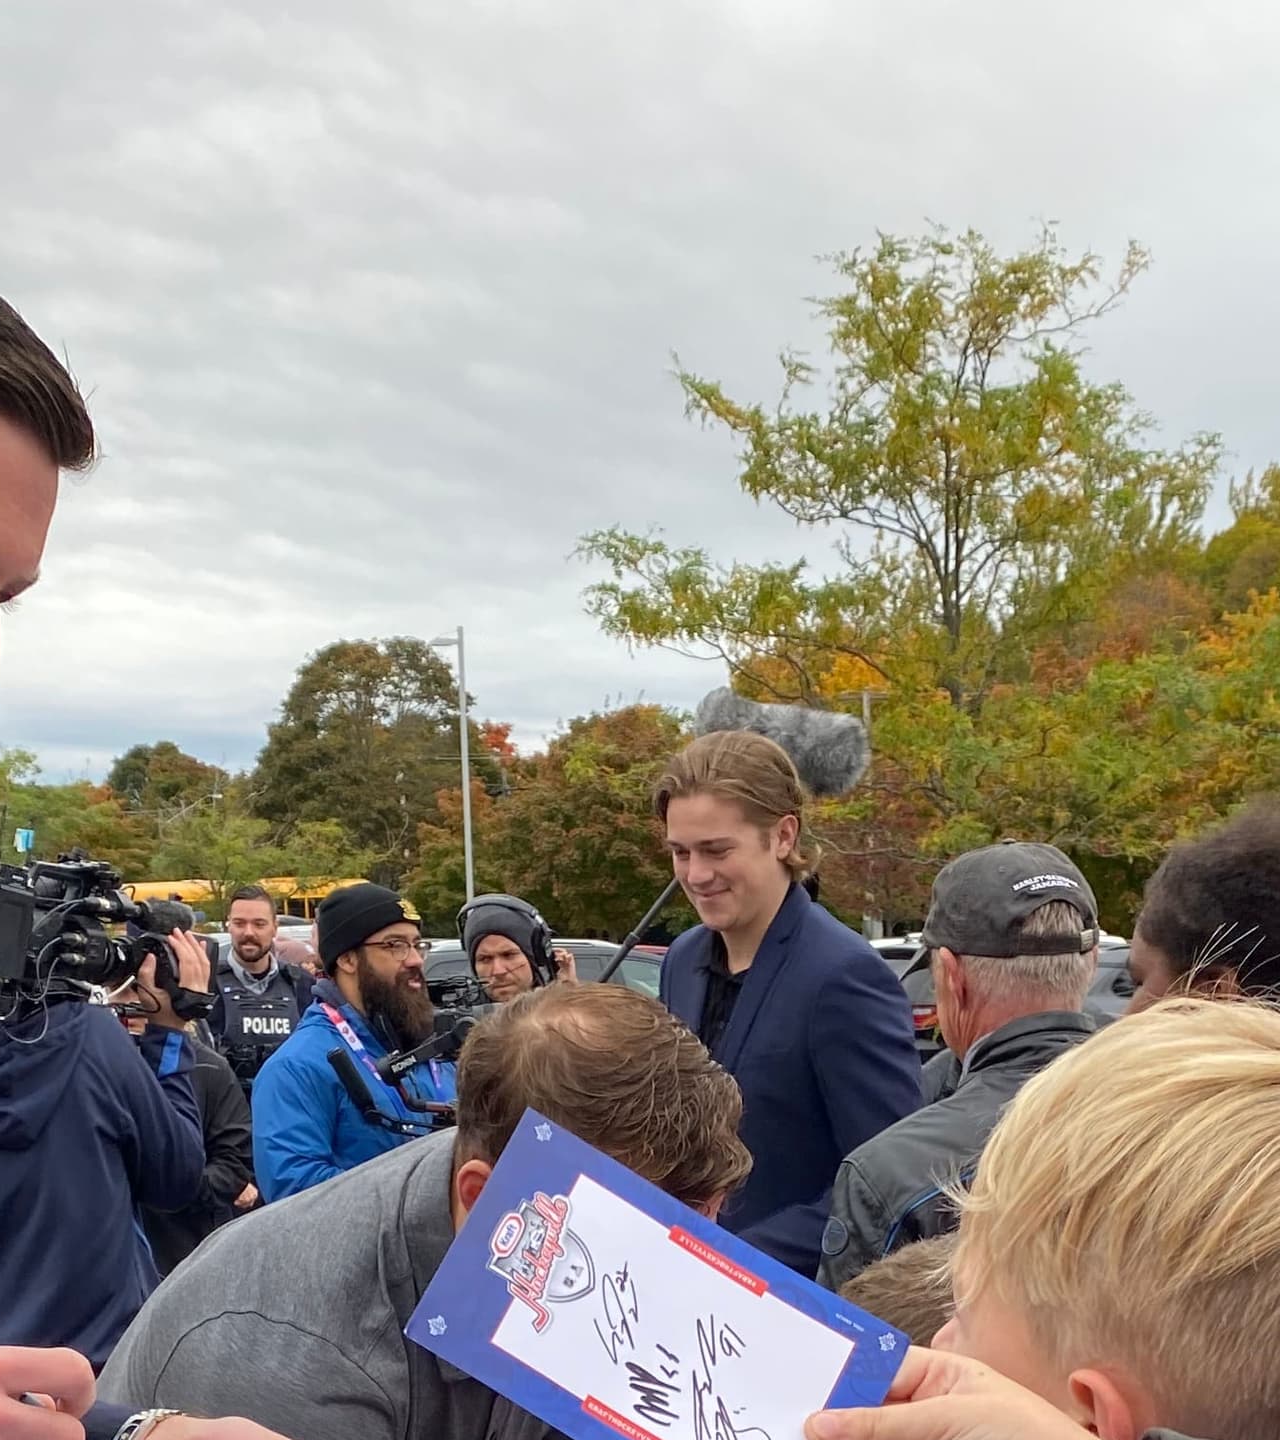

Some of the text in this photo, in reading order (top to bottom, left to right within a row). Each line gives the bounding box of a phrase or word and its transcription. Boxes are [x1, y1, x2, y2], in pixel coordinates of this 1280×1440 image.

[242, 1016, 291, 1034] POLICE
[499, 1223, 518, 1247] Kraft
[510, 1193, 569, 1334] Hockeyville
